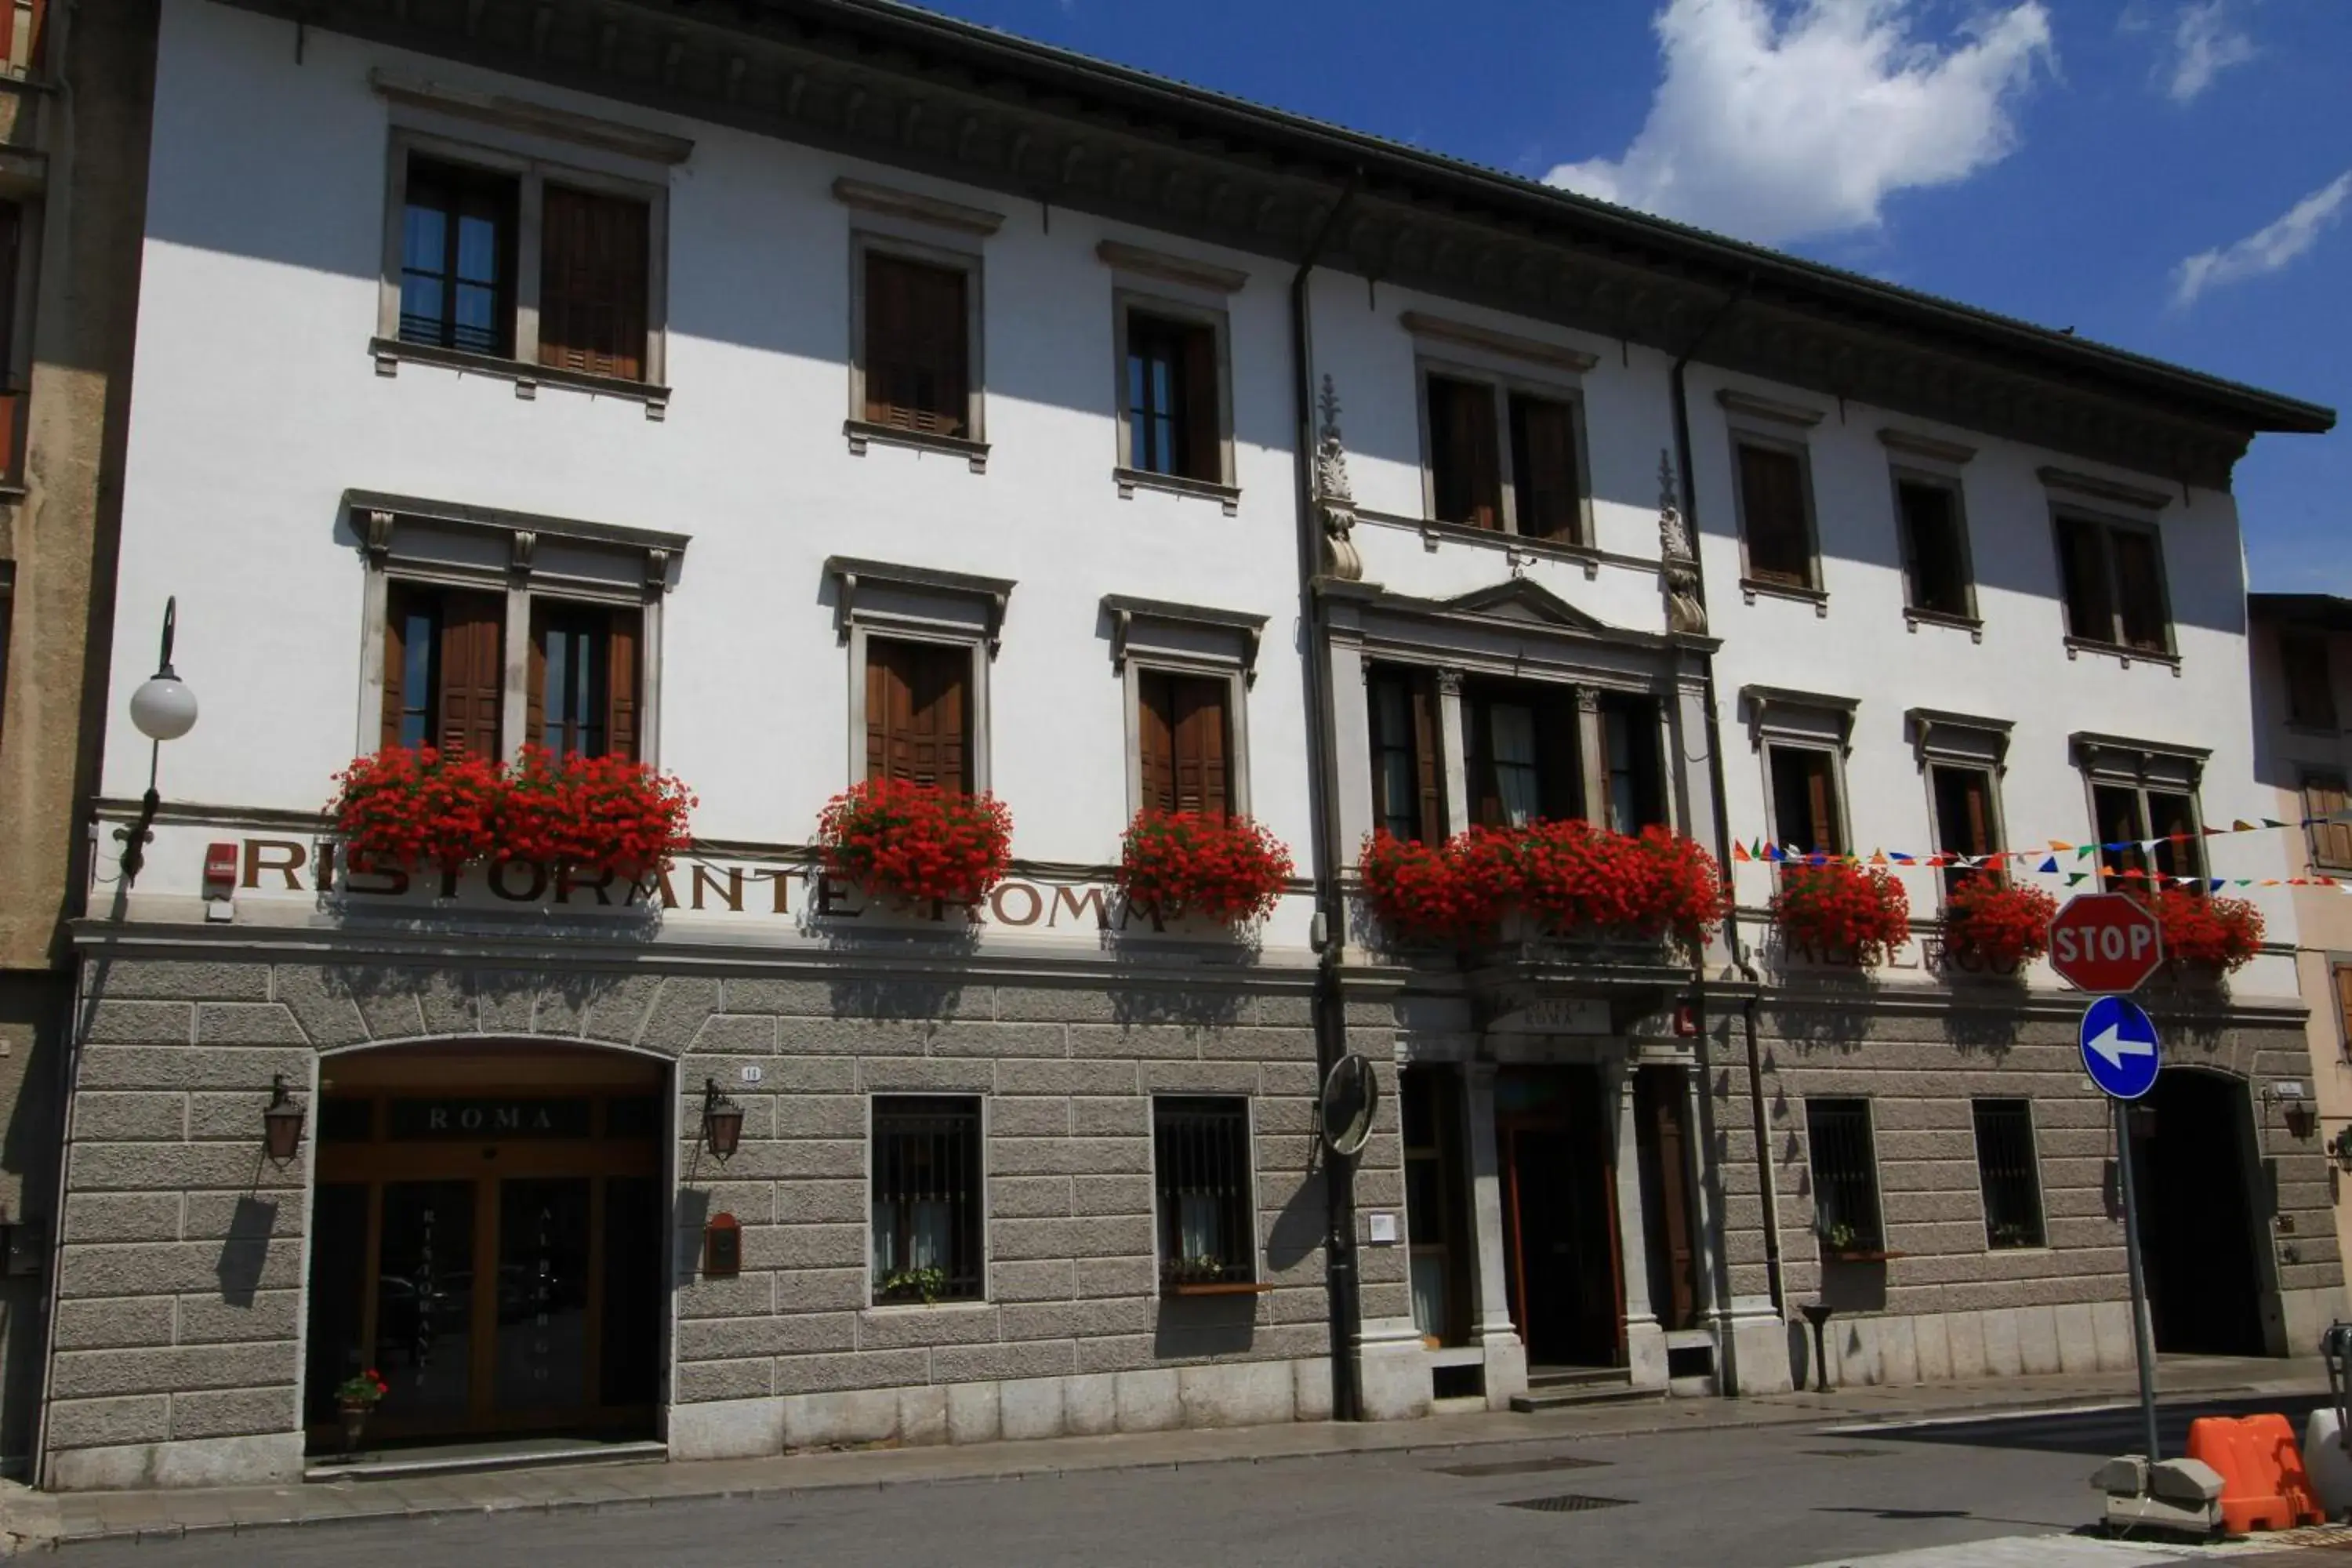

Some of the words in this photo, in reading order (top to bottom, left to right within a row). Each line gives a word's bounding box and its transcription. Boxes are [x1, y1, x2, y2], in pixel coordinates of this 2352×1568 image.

[2056, 924, 2152, 963] STOP
[429, 1105, 552, 1130] ROMA
[533, 1205, 553, 1381] ALBERGO
